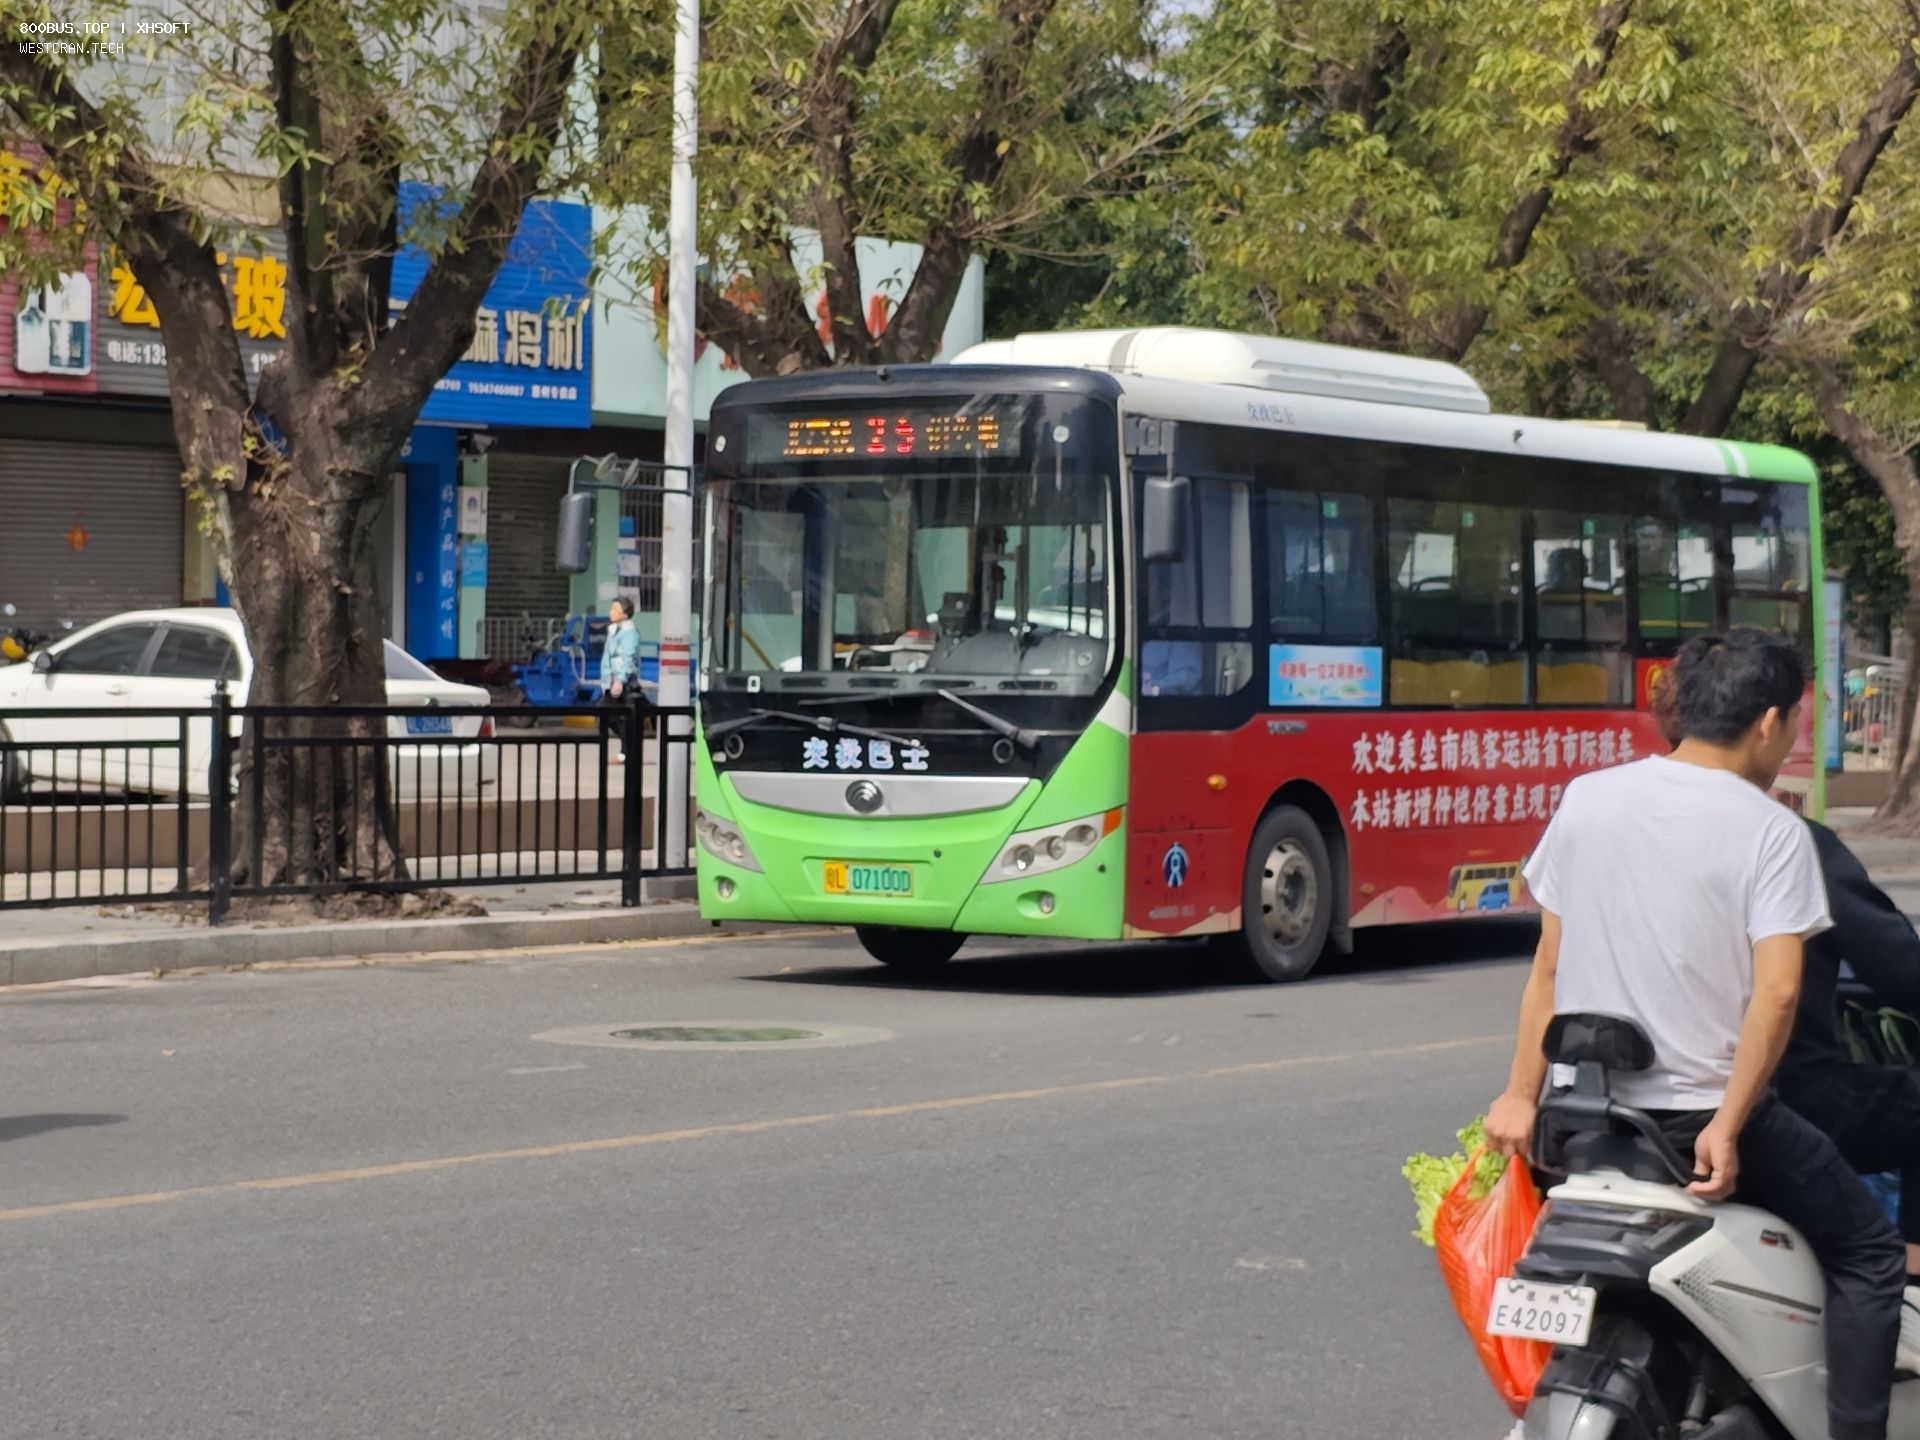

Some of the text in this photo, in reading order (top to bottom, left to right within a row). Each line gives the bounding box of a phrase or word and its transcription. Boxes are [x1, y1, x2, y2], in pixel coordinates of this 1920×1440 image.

[1351, 727, 1634, 774] 欢迎乘坐南线客运站省市际班车
[1496, 1305, 1582, 1334] E42097
